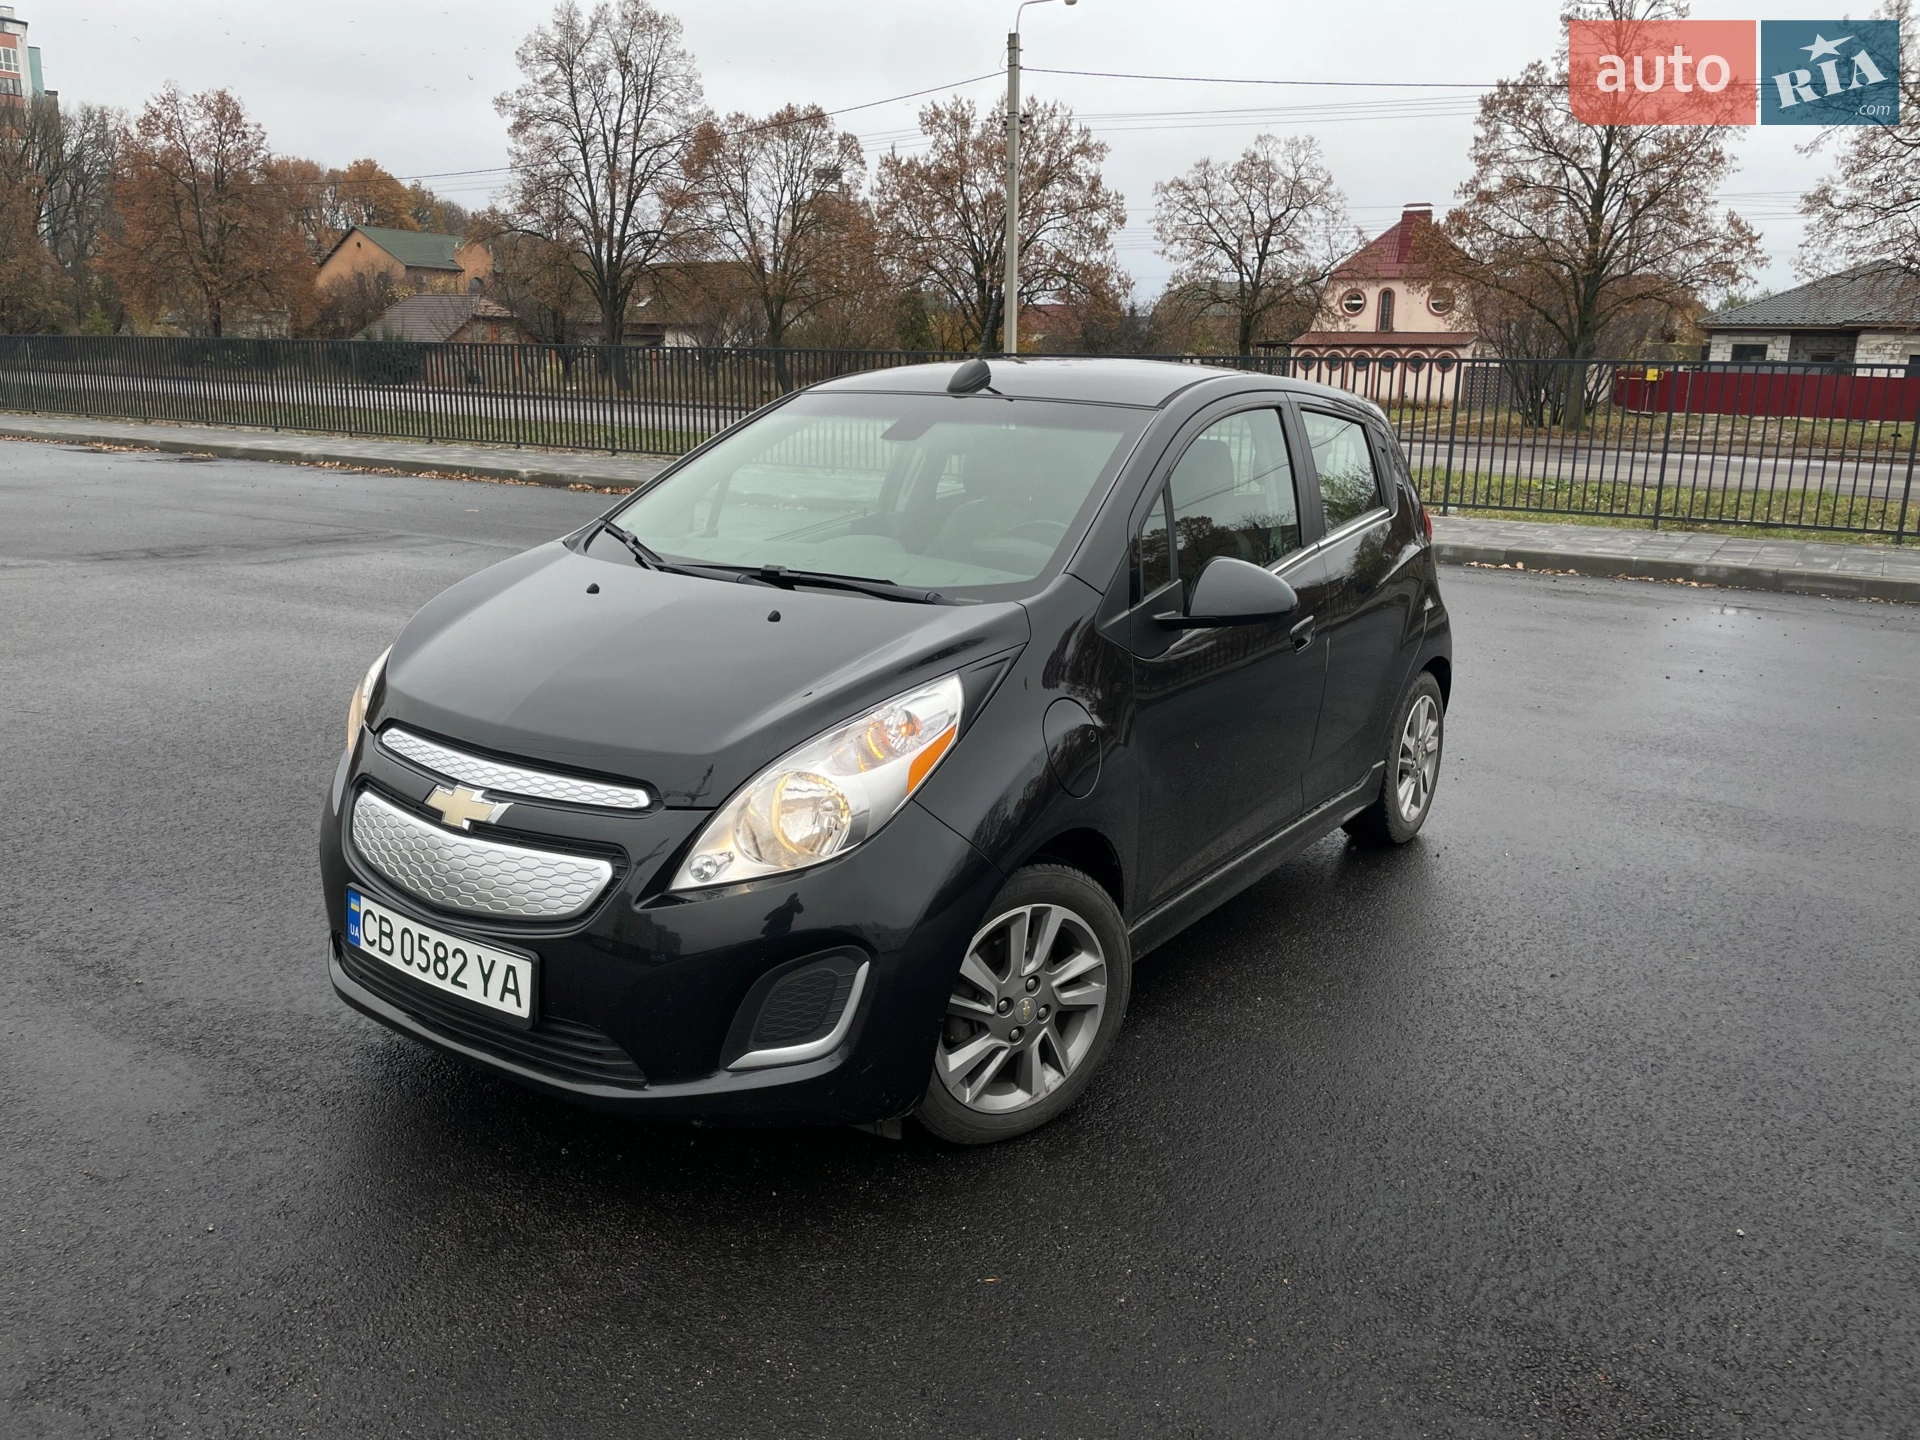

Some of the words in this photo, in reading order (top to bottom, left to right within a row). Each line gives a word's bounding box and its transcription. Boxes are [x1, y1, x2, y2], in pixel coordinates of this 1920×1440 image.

[350, 923, 359, 939] UA
[362, 908, 395, 956] CB
[400, 927, 468, 990] 0582
[476, 954, 522, 1008] YA
